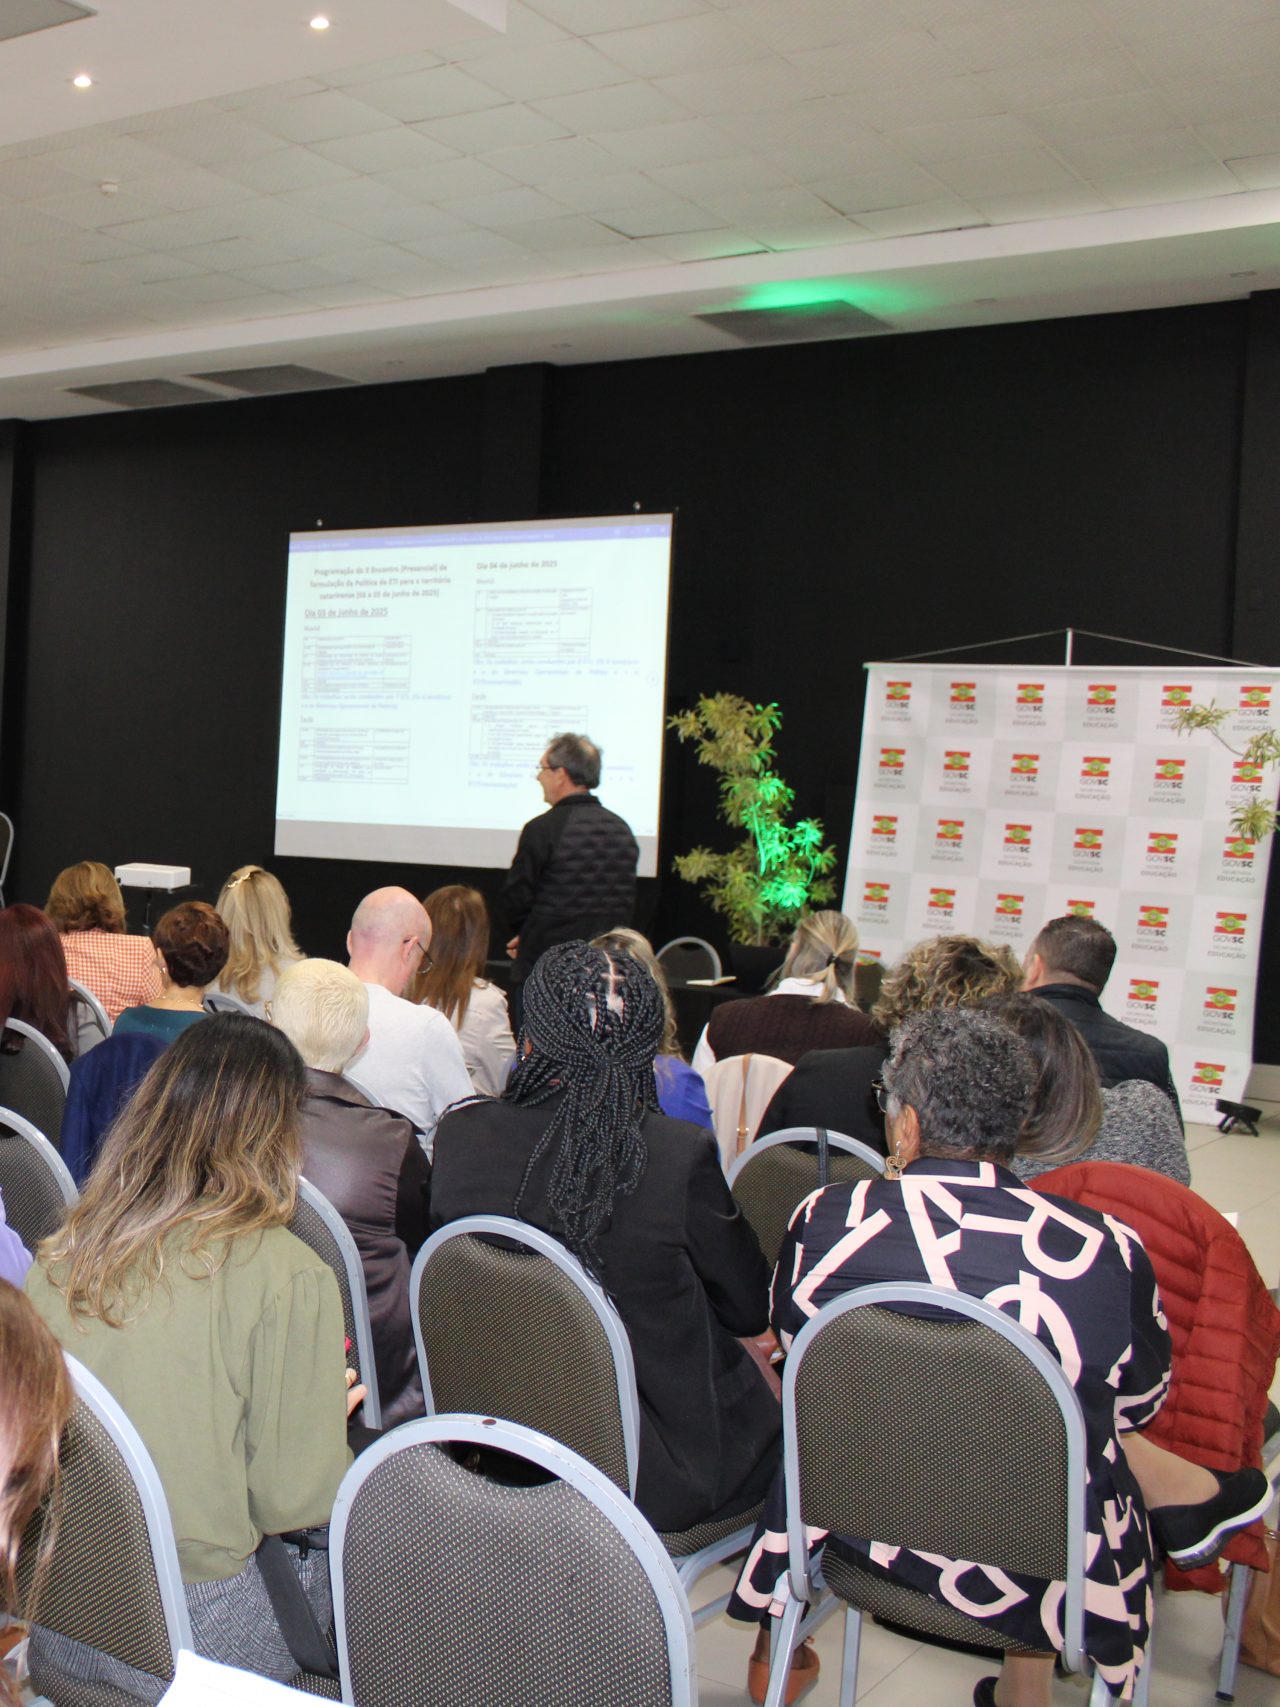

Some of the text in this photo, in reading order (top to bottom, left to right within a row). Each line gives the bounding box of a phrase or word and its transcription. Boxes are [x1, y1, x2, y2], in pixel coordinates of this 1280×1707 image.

[950, 703, 975, 711] GOVSC
[1016, 705, 1042, 713] GOVSC
[1087, 707, 1115, 715] GOVSC
[1239, 709, 1269, 717] GOVSC
[943, 772, 968, 780] GOVSC
[1010, 775, 1036, 783] GOVSC
[1080, 778, 1108, 786] GOVSC
[1153, 781, 1182, 789] GOVSC
[871, 836, 895, 844] GOVSC
[936, 840, 962, 849] GOVSC
[1003, 845, 1030, 854] GOVSC
[1073, 850, 1101, 858] GOVSC
[1146, 855, 1174, 863] GOVSC
[1222, 860, 1252, 869] GOVSC
[863, 903, 887, 911] GOVSC
[927, 909, 953, 917] GOVSC
[994, 915, 1021, 924] GOVSC
[1137, 928, 1165, 937] GOVSC
[1213, 935, 1243, 944] GOVSC
[1132, 944, 1168, 952] EDUCAÇÃO
[1207, 951, 1246, 959] EDUCAÇÃO
[1127, 1001, 1155, 1011] GOVSC
[1203, 1010, 1233, 1020] GOVSC
[1197, 1026, 1235, 1035] EDUCAÇÃO
[1189, 1084, 1220, 1094] GOVSC
